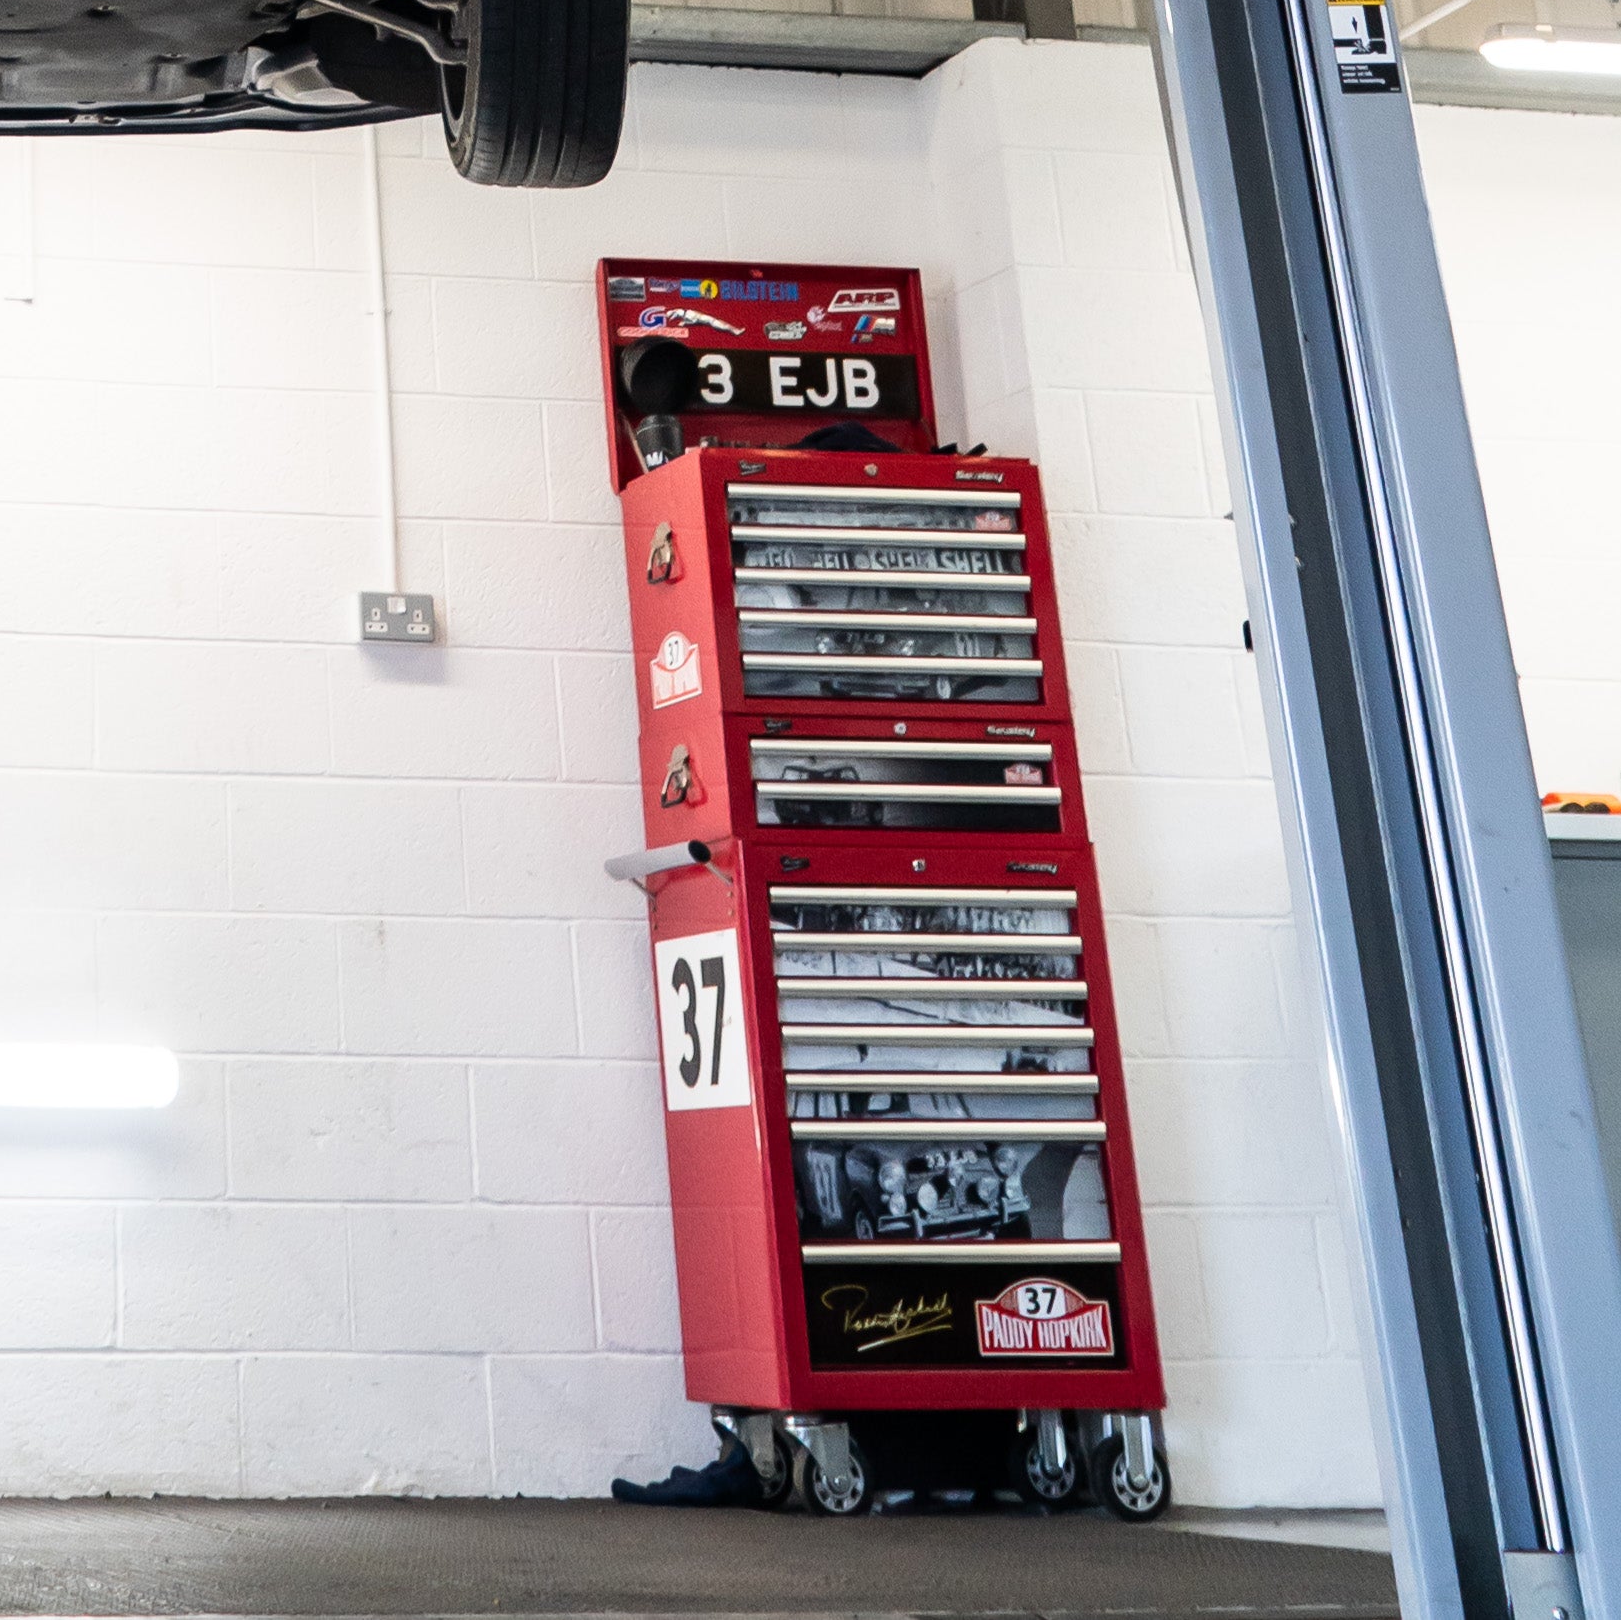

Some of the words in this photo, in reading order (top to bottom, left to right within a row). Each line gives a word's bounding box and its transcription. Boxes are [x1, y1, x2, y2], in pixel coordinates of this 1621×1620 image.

[719, 279, 800, 302] BILSTEIN
[834, 292, 896, 304] ARP
[769, 356, 880, 409] EJB
[671, 956, 726, 1089] 37
[1024, 1287, 1057, 1315] 37
[981, 1305, 1034, 1349] PADDY
[1037, 1305, 1108, 1349] HOPKIRK
